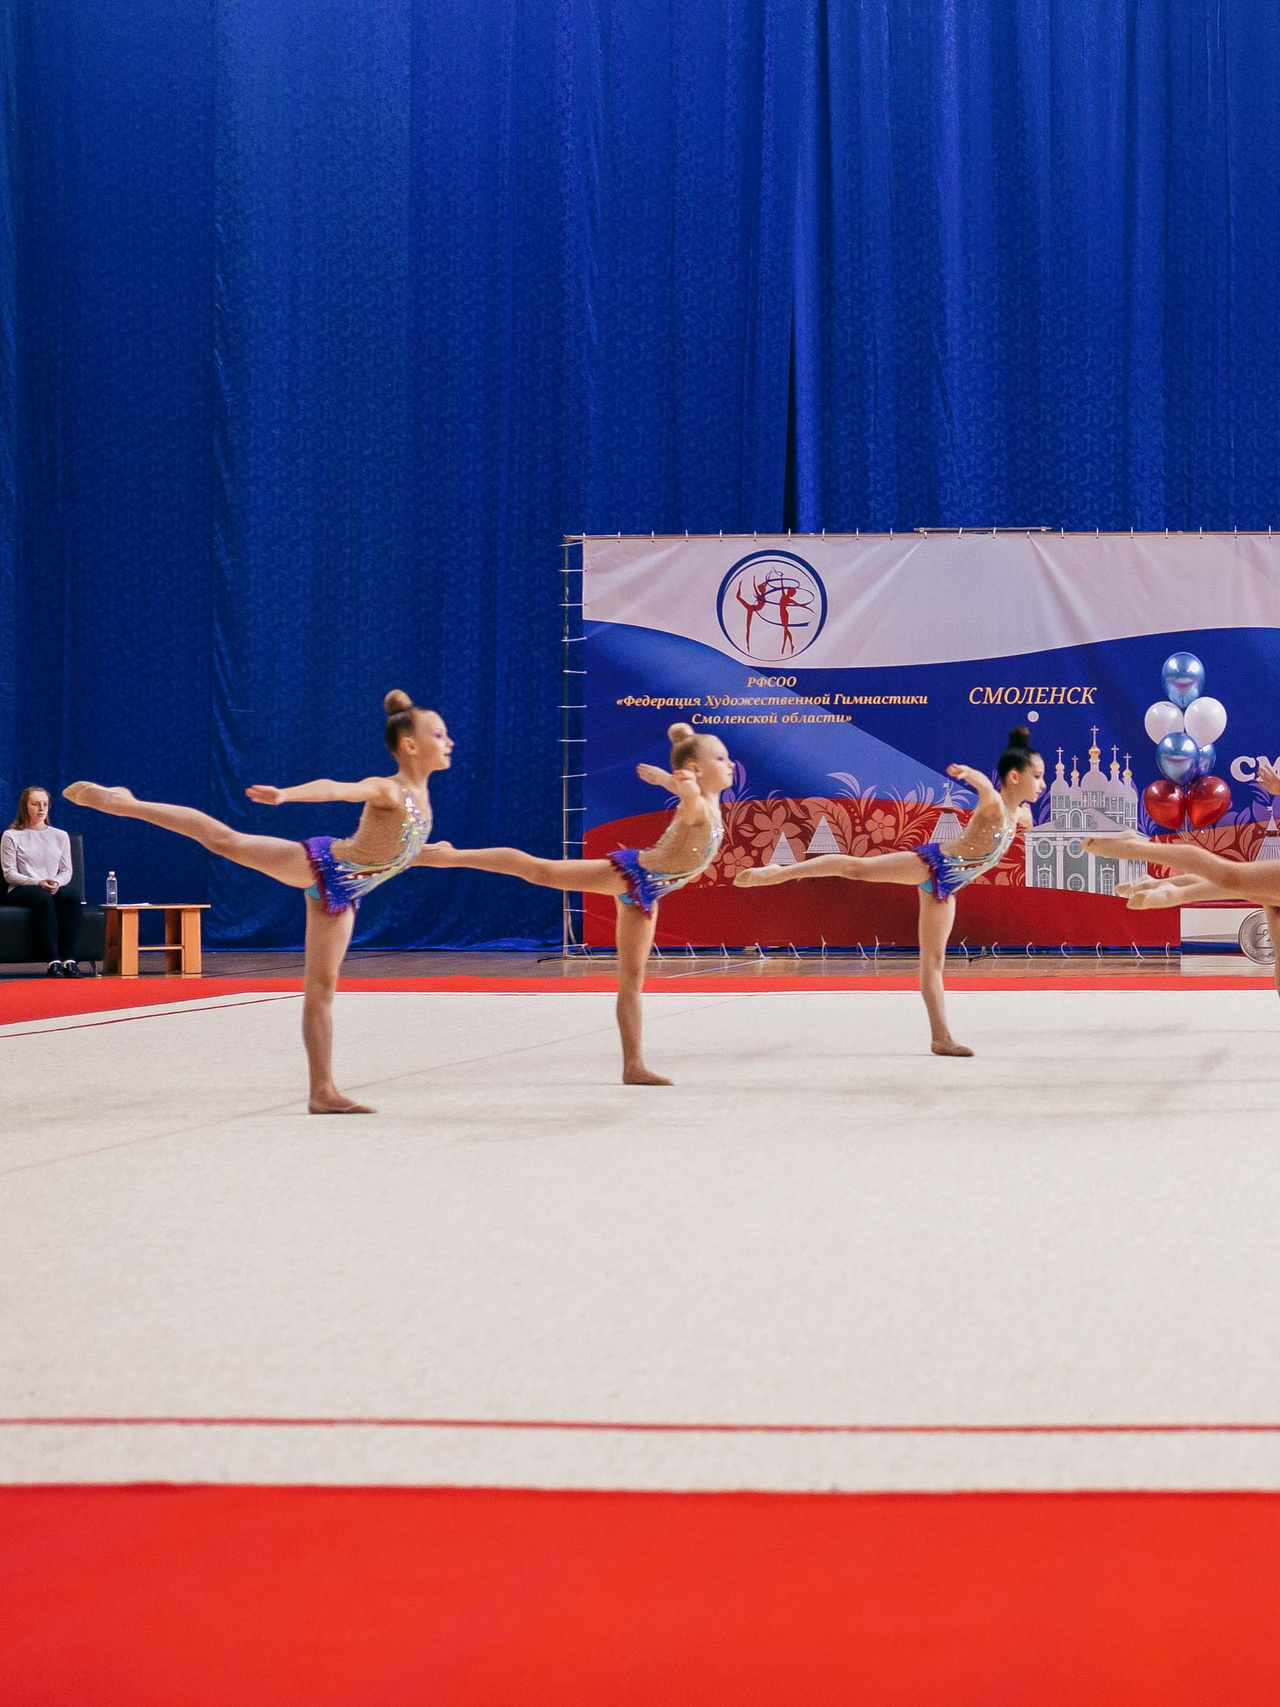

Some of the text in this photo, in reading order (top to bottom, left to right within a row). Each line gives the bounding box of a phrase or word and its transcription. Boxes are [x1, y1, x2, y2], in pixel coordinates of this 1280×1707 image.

[746, 676, 797, 688] РФСОО
[616, 693, 928, 709] «Федерация Художественной Гимнастики
[968, 686, 1098, 705] СМОЛЕНСК
[691, 712, 852, 725] Смоленской области»
